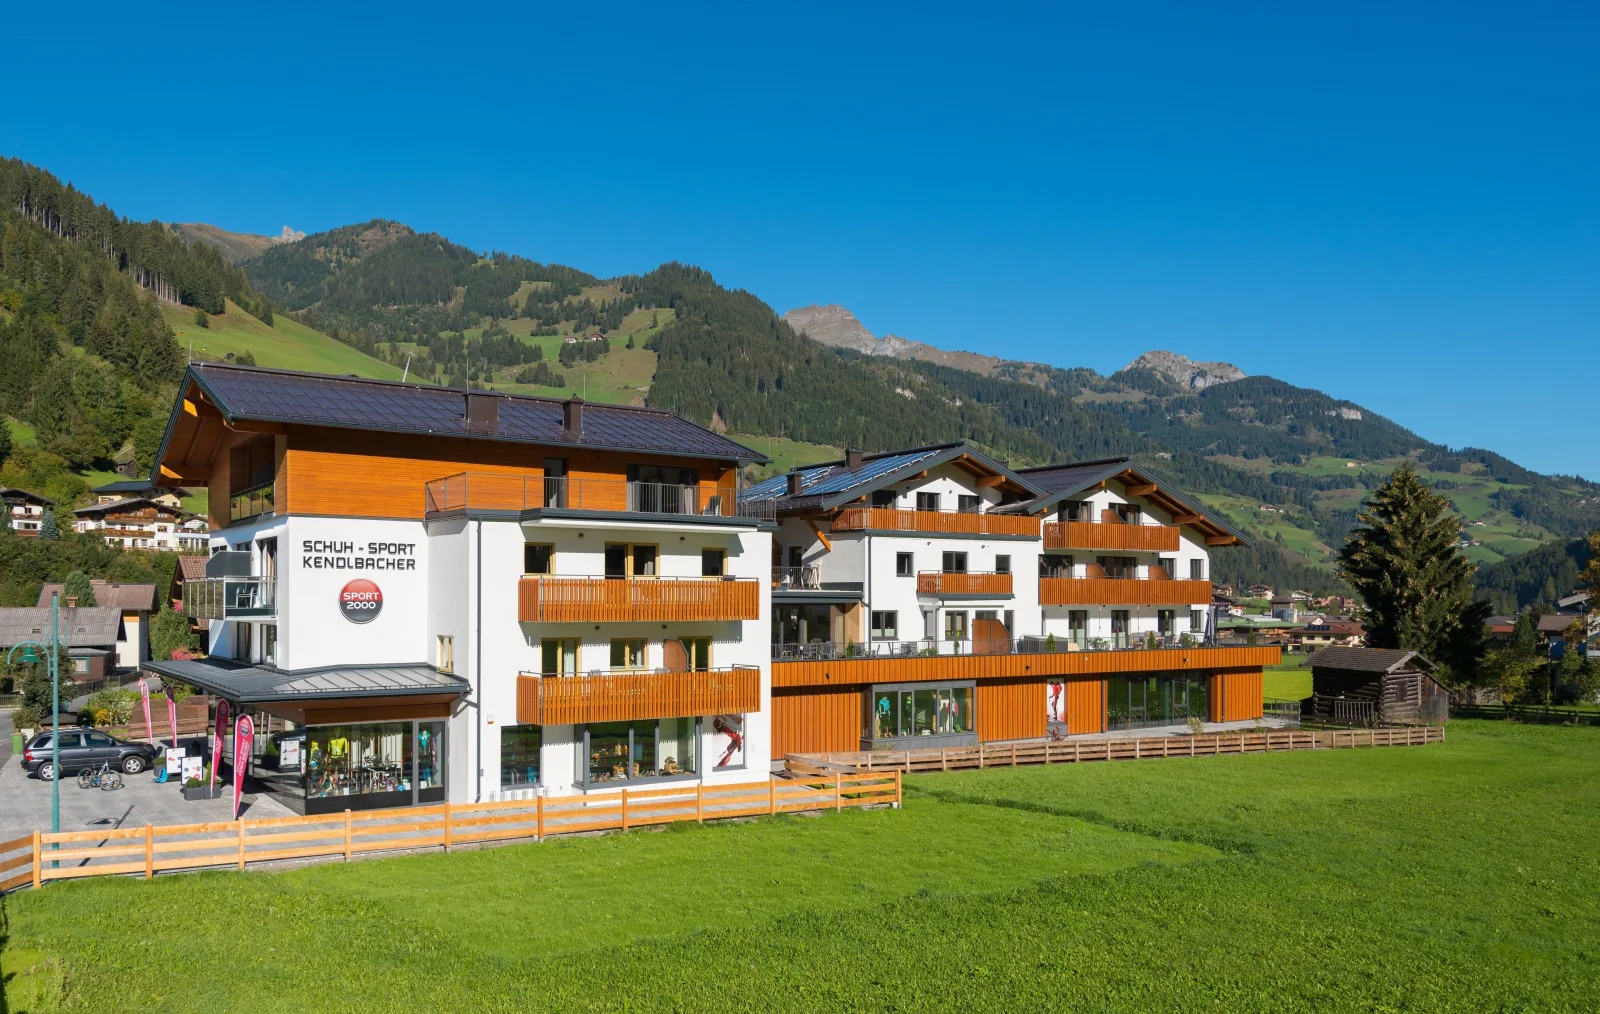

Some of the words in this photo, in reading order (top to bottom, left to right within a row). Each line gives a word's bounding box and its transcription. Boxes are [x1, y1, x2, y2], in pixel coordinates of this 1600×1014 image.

[302, 540, 353, 553] SCHUH
[368, 542, 416, 555] SPORT
[302, 556, 416, 570] KENDLBACHER
[343, 592, 379, 600] SPORT
